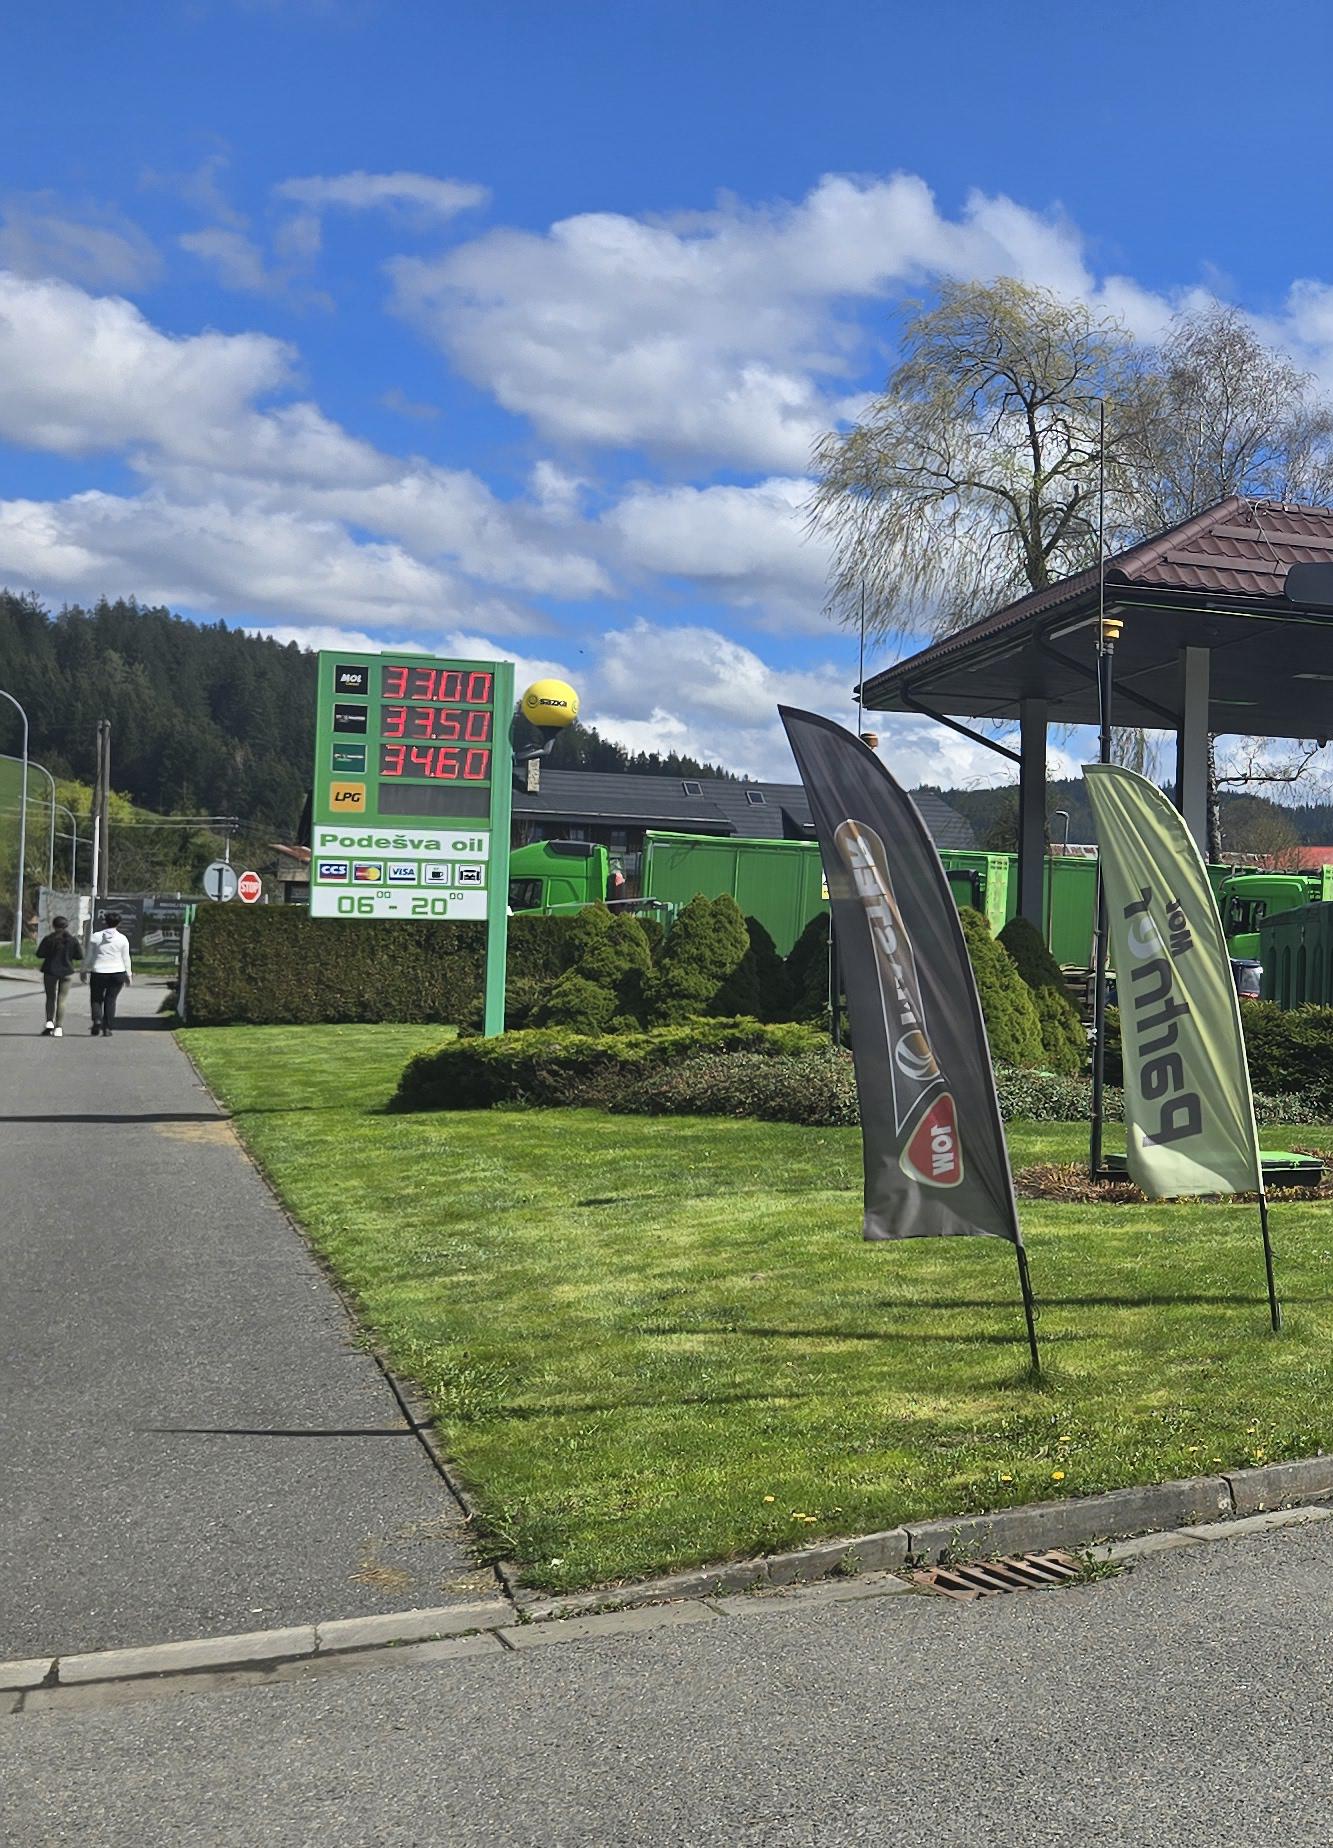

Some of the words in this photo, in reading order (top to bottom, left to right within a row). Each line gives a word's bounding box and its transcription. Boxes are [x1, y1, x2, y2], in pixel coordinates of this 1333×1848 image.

[383, 667, 492, 703] 33.00
[382, 706, 491, 741] 33.50
[380, 744, 489, 779] 34.60
[334, 792, 361, 803] LPG
[320, 834, 441, 851] Podešva
[452, 839, 483, 852] oil
[321, 866, 346, 874] CCS
[392, 868, 415, 876] VISA
[240, 881, 259, 893] STOP
